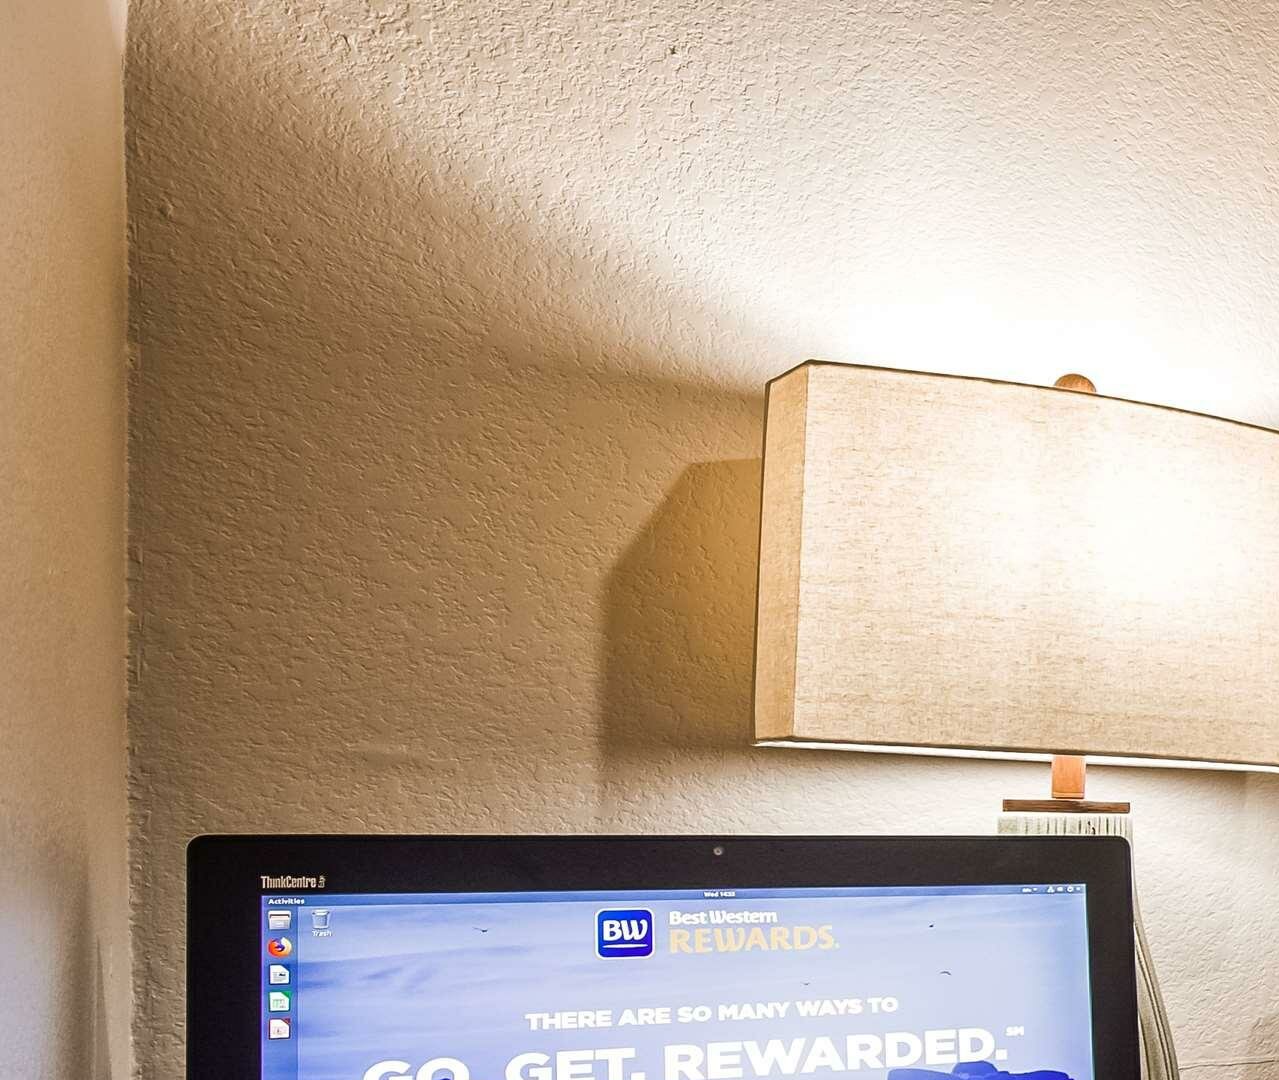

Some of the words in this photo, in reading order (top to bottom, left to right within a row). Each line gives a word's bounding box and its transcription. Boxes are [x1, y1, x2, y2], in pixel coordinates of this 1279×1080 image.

[260, 875, 317, 889] ThinkCentre
[669, 910, 707, 925] Best
[709, 910, 778, 925] Western
[603, 919, 648, 942] BW
[525, 1008, 613, 1031] THERE
[618, 1006, 671, 1027] ARE
[676, 1004, 713, 1023] SO
[717, 1001, 792, 1022] MANY
[796, 998, 865, 1018] WAYS
[866, 996, 899, 1014] TO
